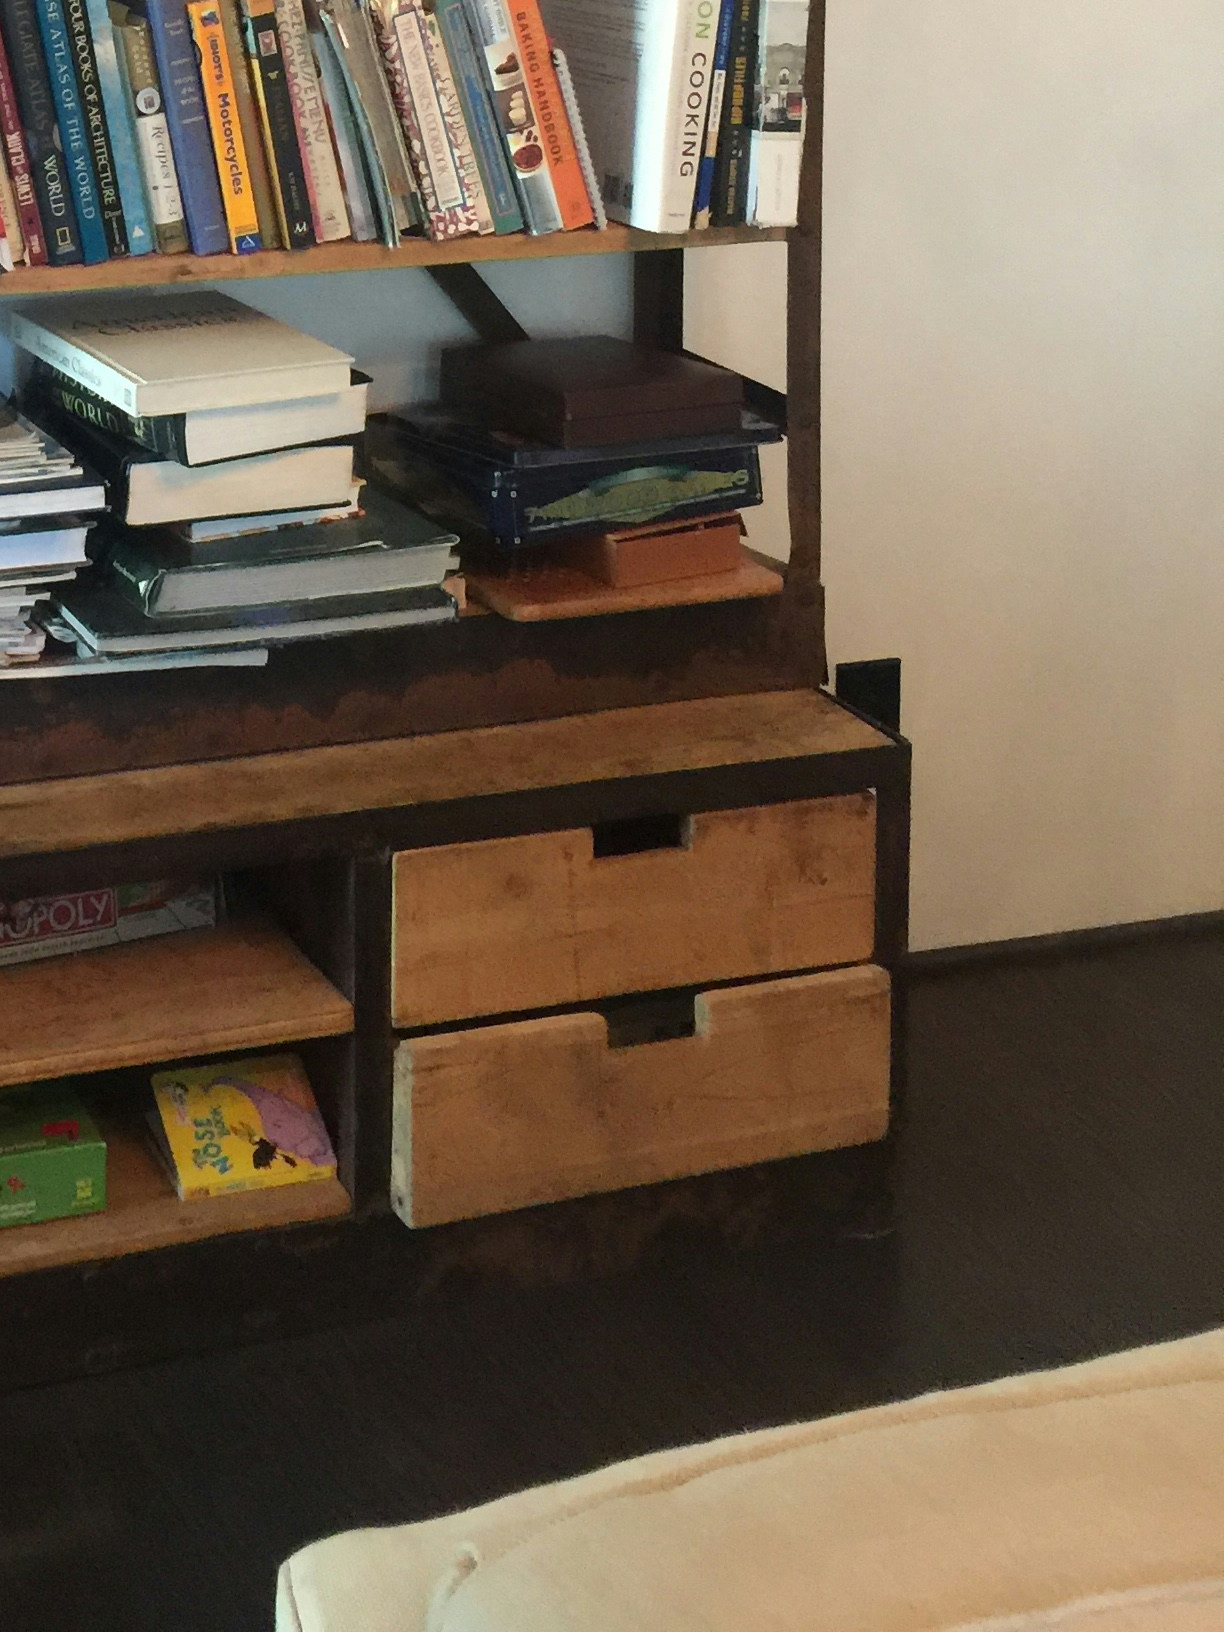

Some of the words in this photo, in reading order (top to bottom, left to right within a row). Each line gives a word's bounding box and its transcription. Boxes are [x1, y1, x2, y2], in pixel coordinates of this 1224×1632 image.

[694, 0, 714, 40] ON
[47, 26, 73, 85] ATLAS
[72, 34, 94, 81] BOOKS
[275, 20, 310, 119] COOKBOOK
[26, 77, 50, 130] ATLAS
[60, 87, 76, 109] OF
[82, 83, 98, 104] OF
[512, 10, 541, 73] BAKING
[530, 77, 566, 166] HANDBOOK
[677, 51, 707, 178] COOKING
[4, 129, 28, 166] CLARK
[64, 116, 84, 149] THE
[209, 91, 249, 196] Motorcycles
[304, 96, 327, 144] MENU
[421, 112, 450, 177] COOKBOOK
[85, 103, 117, 205] ARCHITECTURE
[149, 124, 173, 181] Recipes
[13, 171, 36, 207] LEWIS
[40, 154, 67, 217] WORLD
[70, 154, 98, 220] WORLD
[62, 390, 120, 433] WORLD
